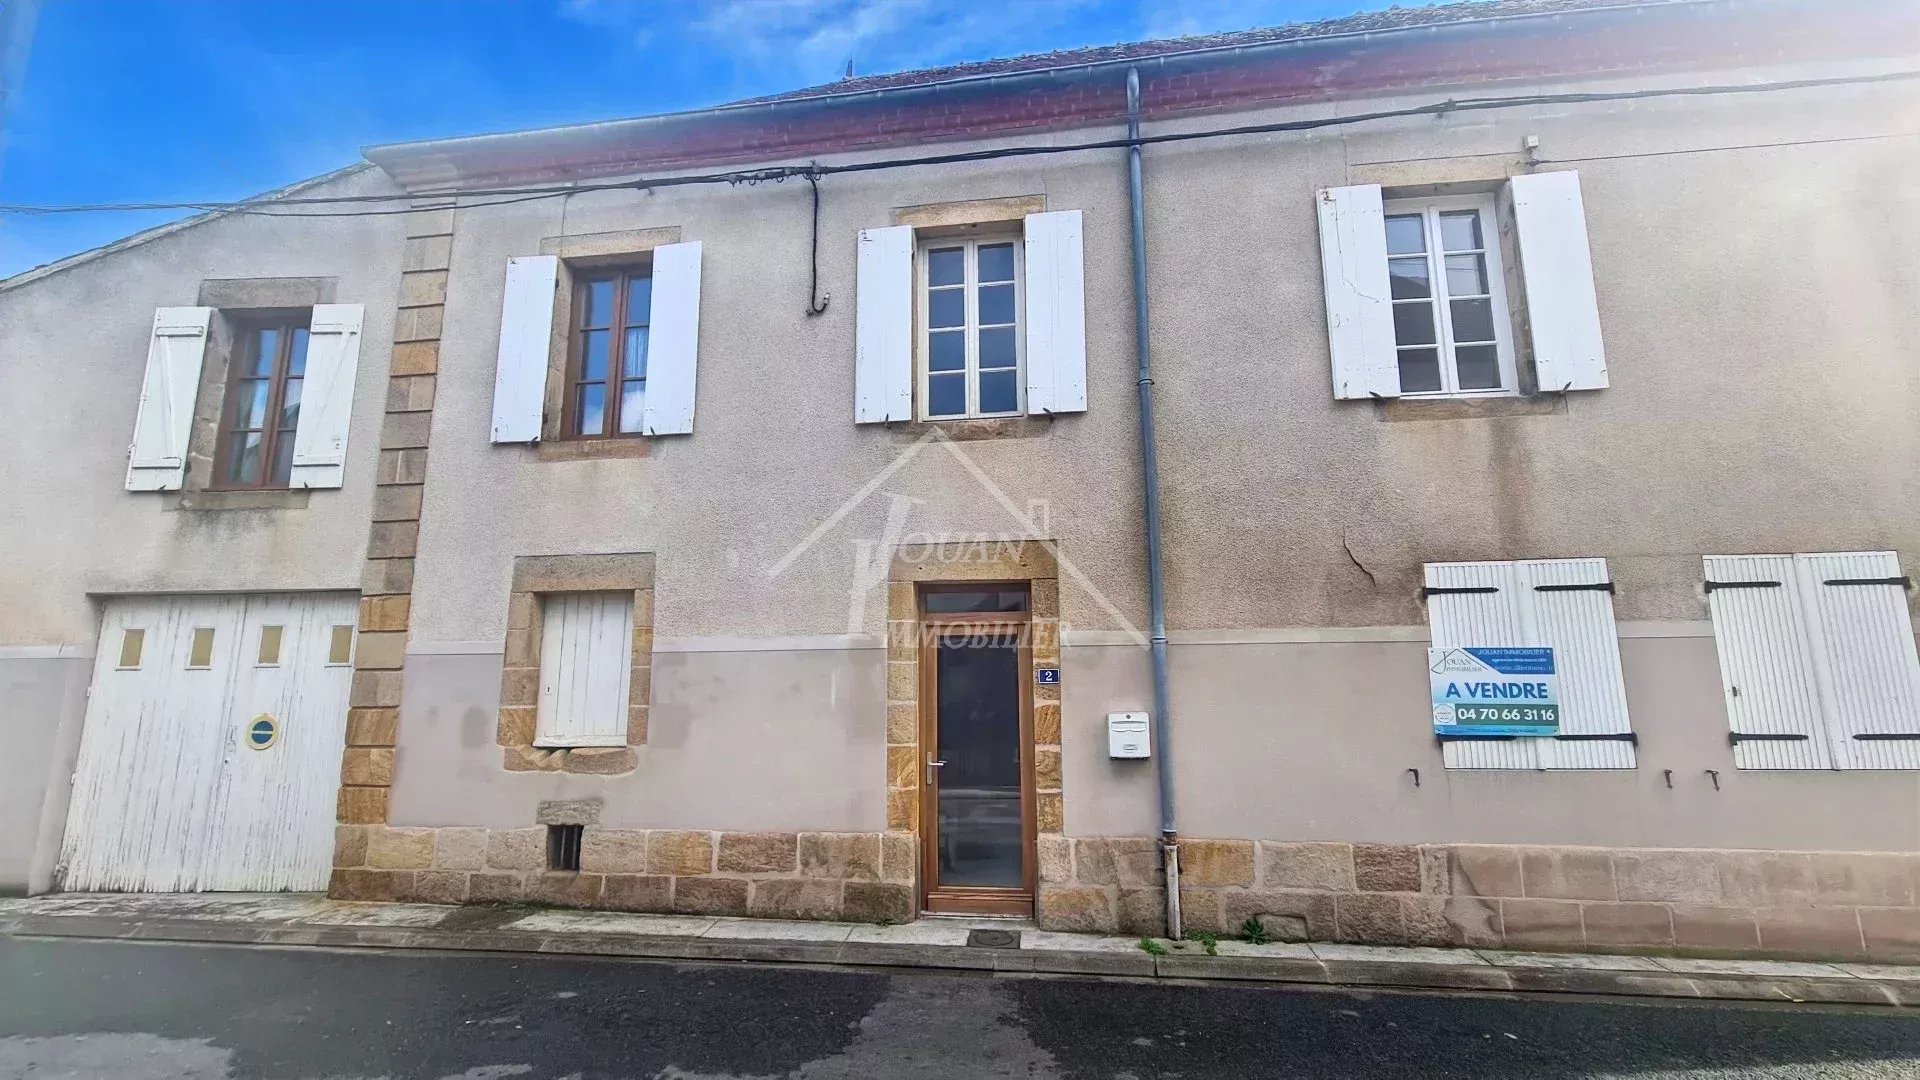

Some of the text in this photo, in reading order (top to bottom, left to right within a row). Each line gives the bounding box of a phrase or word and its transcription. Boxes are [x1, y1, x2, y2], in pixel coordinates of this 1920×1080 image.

[1045, 671, 1053, 681] 2
[1446, 682, 1548, 699] A VENDRE
[1458, 708, 1477, 720] 04
[1480, 708, 1499, 720] 70
[1502, 708, 1521, 720] 66
[1524, 709, 1538, 720] 31
[1541, 709, 1555, 721] 16
